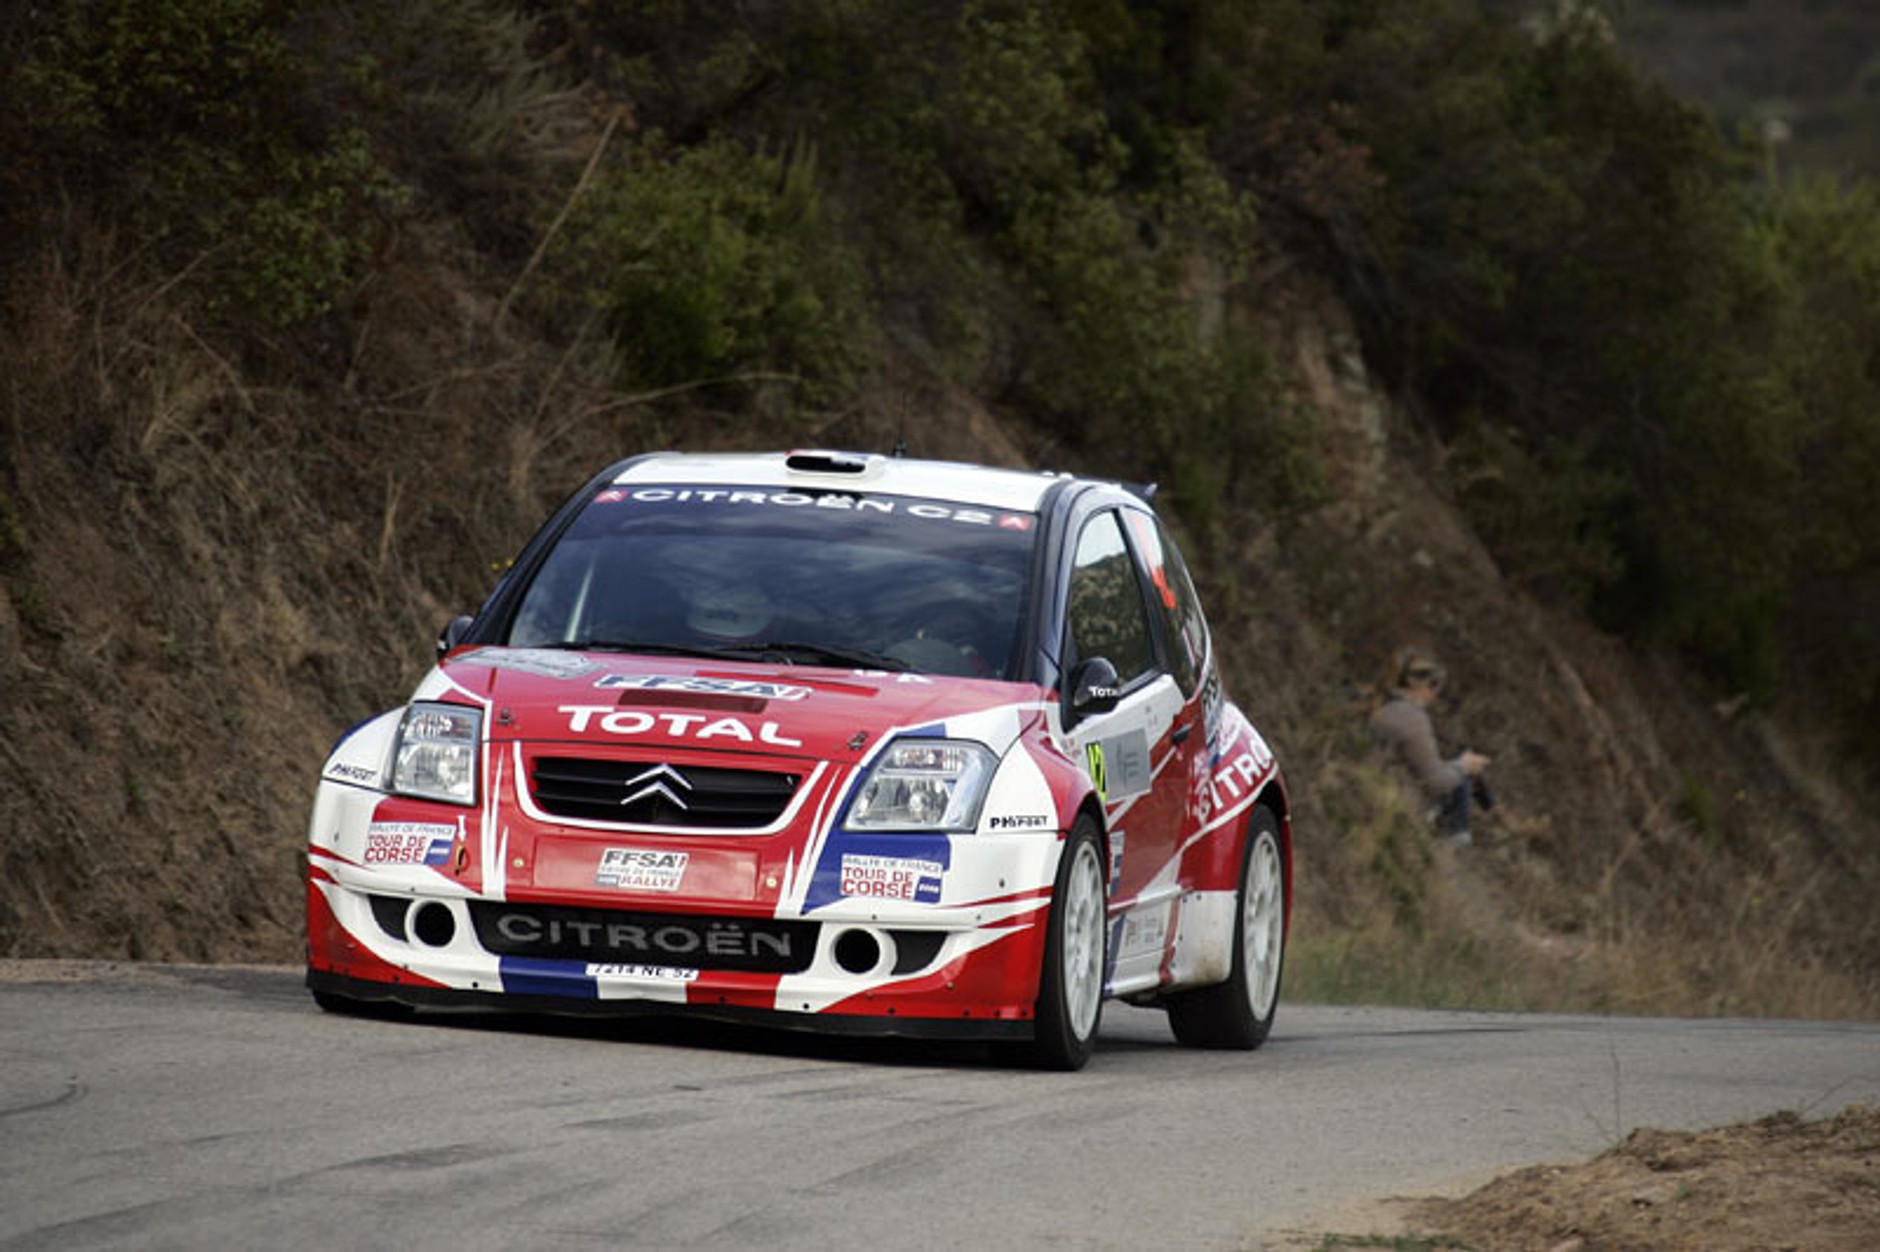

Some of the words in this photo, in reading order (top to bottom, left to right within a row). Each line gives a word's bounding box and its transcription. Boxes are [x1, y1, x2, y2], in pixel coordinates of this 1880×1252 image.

[632, 490, 894, 513] CITROËN
[907, 504, 992, 525] C2
[559, 705, 802, 746] TOTAL
[368, 834, 403, 847] TOUR
[407, 836, 426, 847] DE
[364, 847, 424, 863] CORSE
[604, 850, 676, 867] FFSA
[843, 867, 887, 880] TOUR
[893, 871, 913, 882] DE
[842, 879, 912, 900] CORSE
[496, 914, 791, 956] CITROËN
